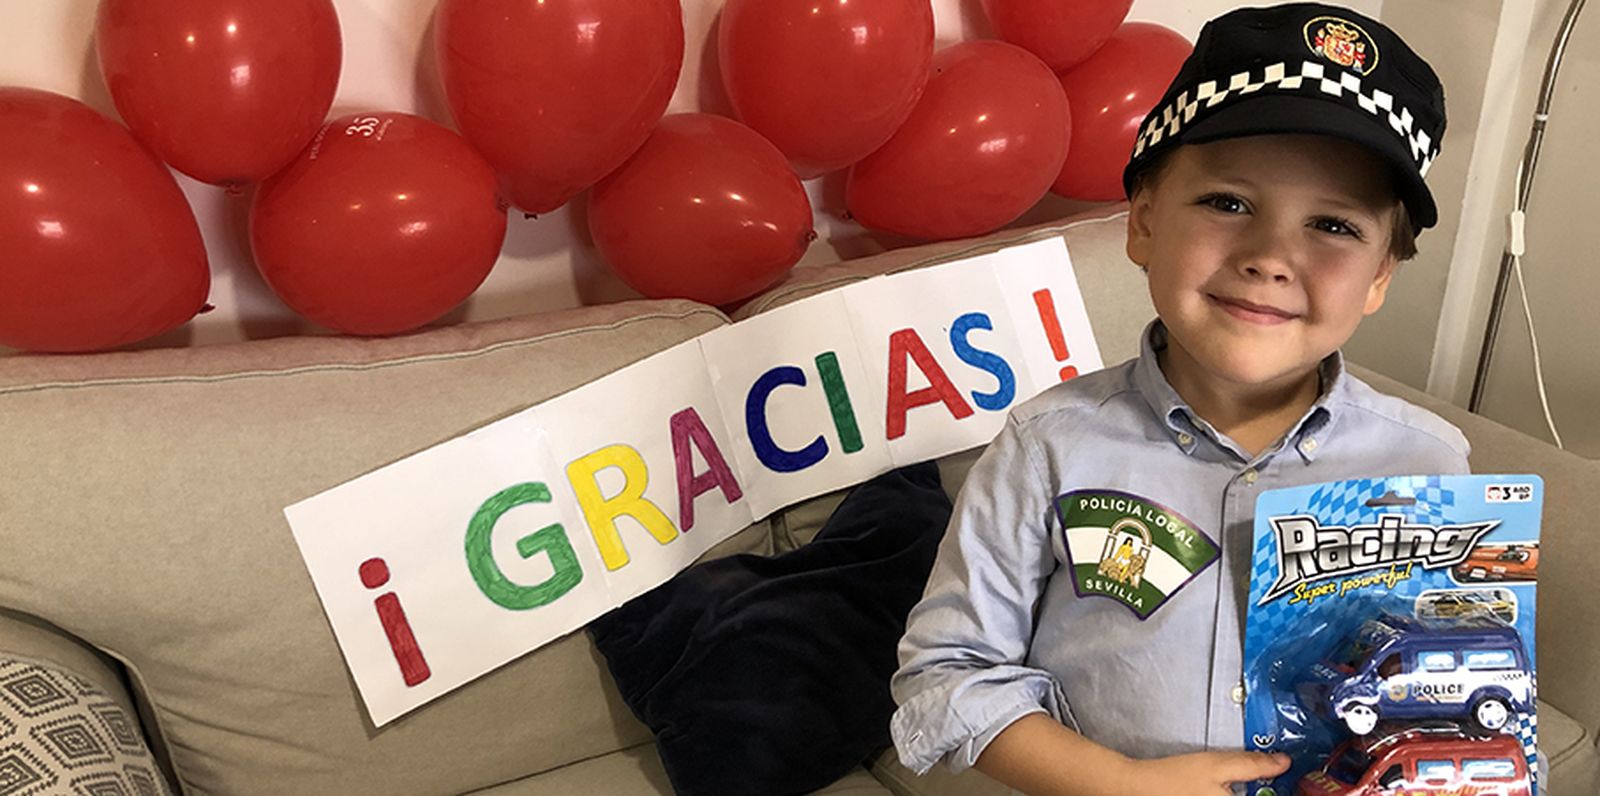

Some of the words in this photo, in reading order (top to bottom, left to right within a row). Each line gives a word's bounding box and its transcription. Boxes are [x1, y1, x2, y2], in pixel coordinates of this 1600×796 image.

[1502, 486, 1511, 500] 3
[1080, 498, 1142, 517] POLICÍA
[1145, 509, 1195, 549] LOCAL
[1258, 513, 1502, 606] Racing
[1085, 578, 1143, 608] SEVILLA
[1289, 579, 1337, 605] Super
[1340, 561, 1413, 596] powerful
[1413, 683, 1464, 696] POLICE
